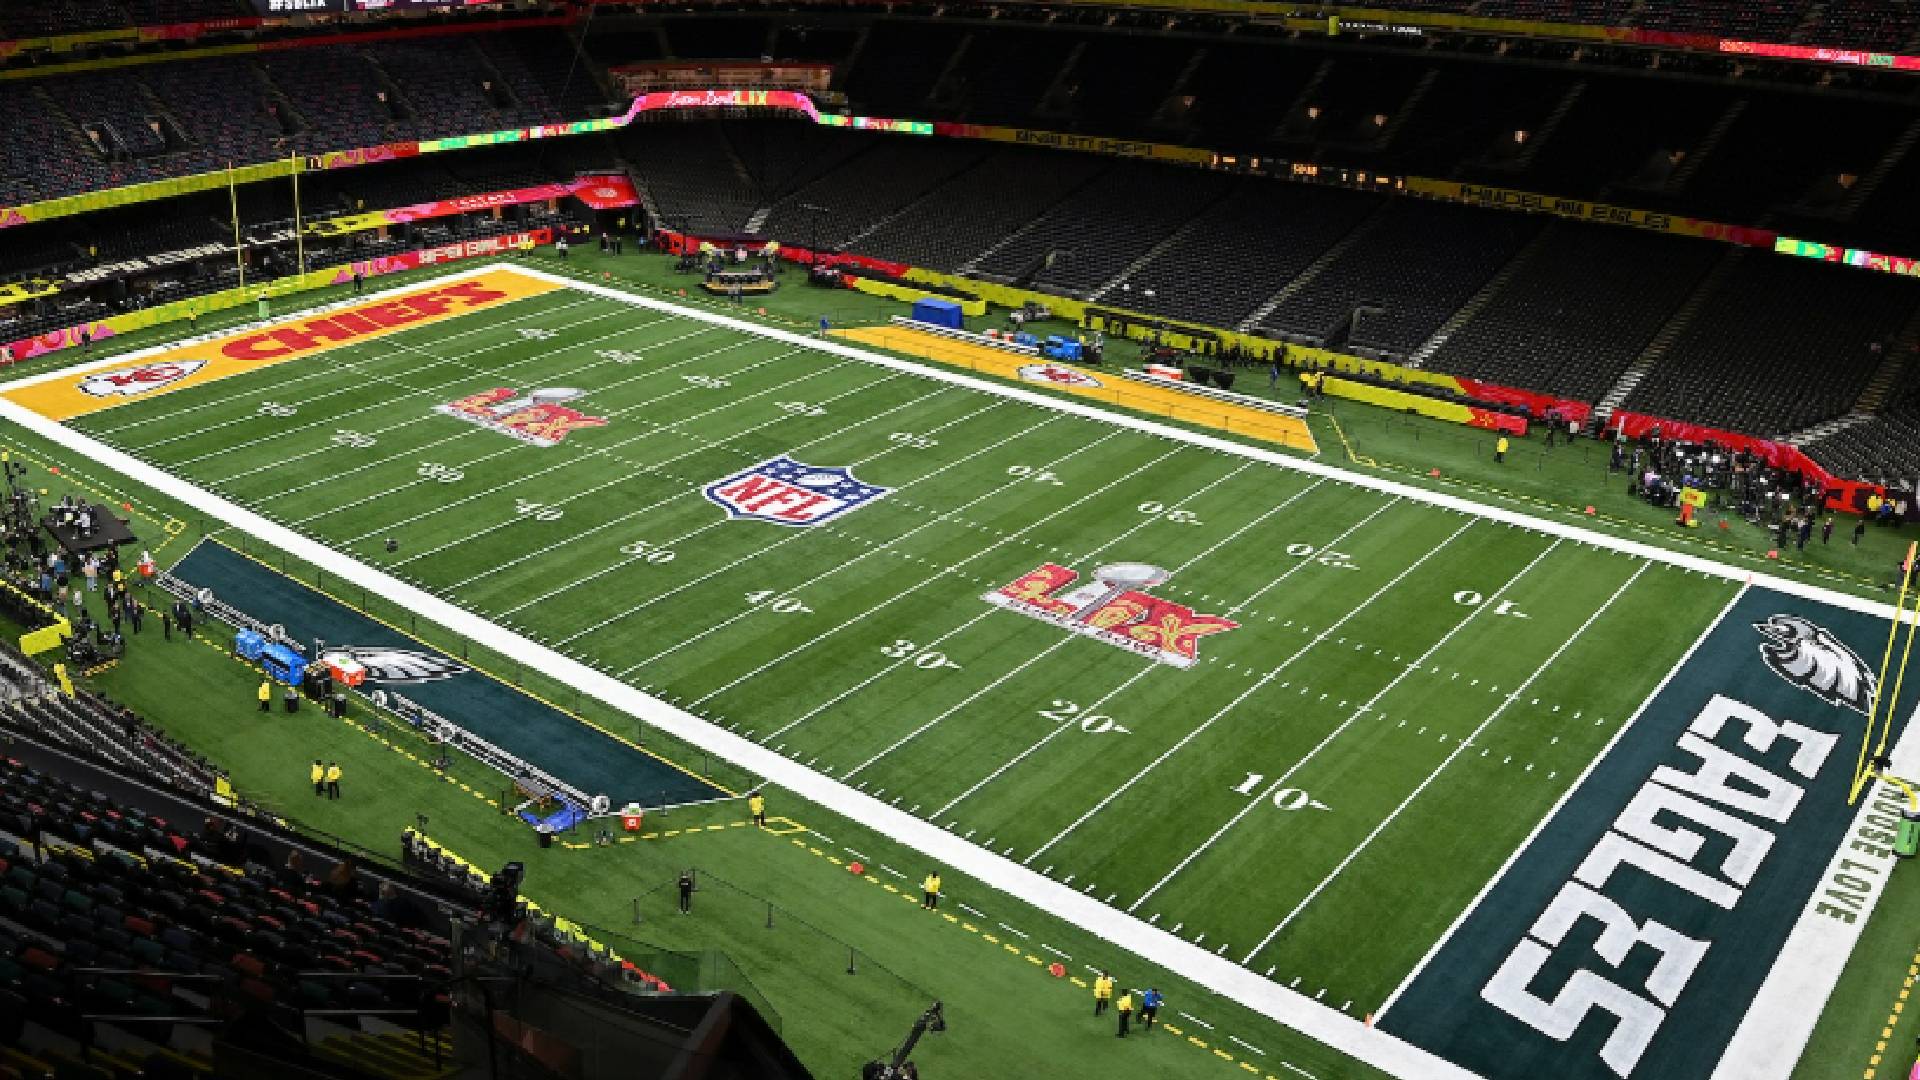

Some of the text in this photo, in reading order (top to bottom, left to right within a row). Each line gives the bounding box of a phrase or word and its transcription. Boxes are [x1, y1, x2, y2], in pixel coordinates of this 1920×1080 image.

[221, 281, 508, 361] CHIEFS
[719, 474, 831, 521] NFL
[744, 590, 803, 613] 40
[880, 639, 947, 669] 30
[1036, 699, 1113, 734] 20
[1229, 771, 1311, 811] 10
[1480, 693, 1842, 1079] EAGLES
[1814, 858, 1881, 925] LOVE
